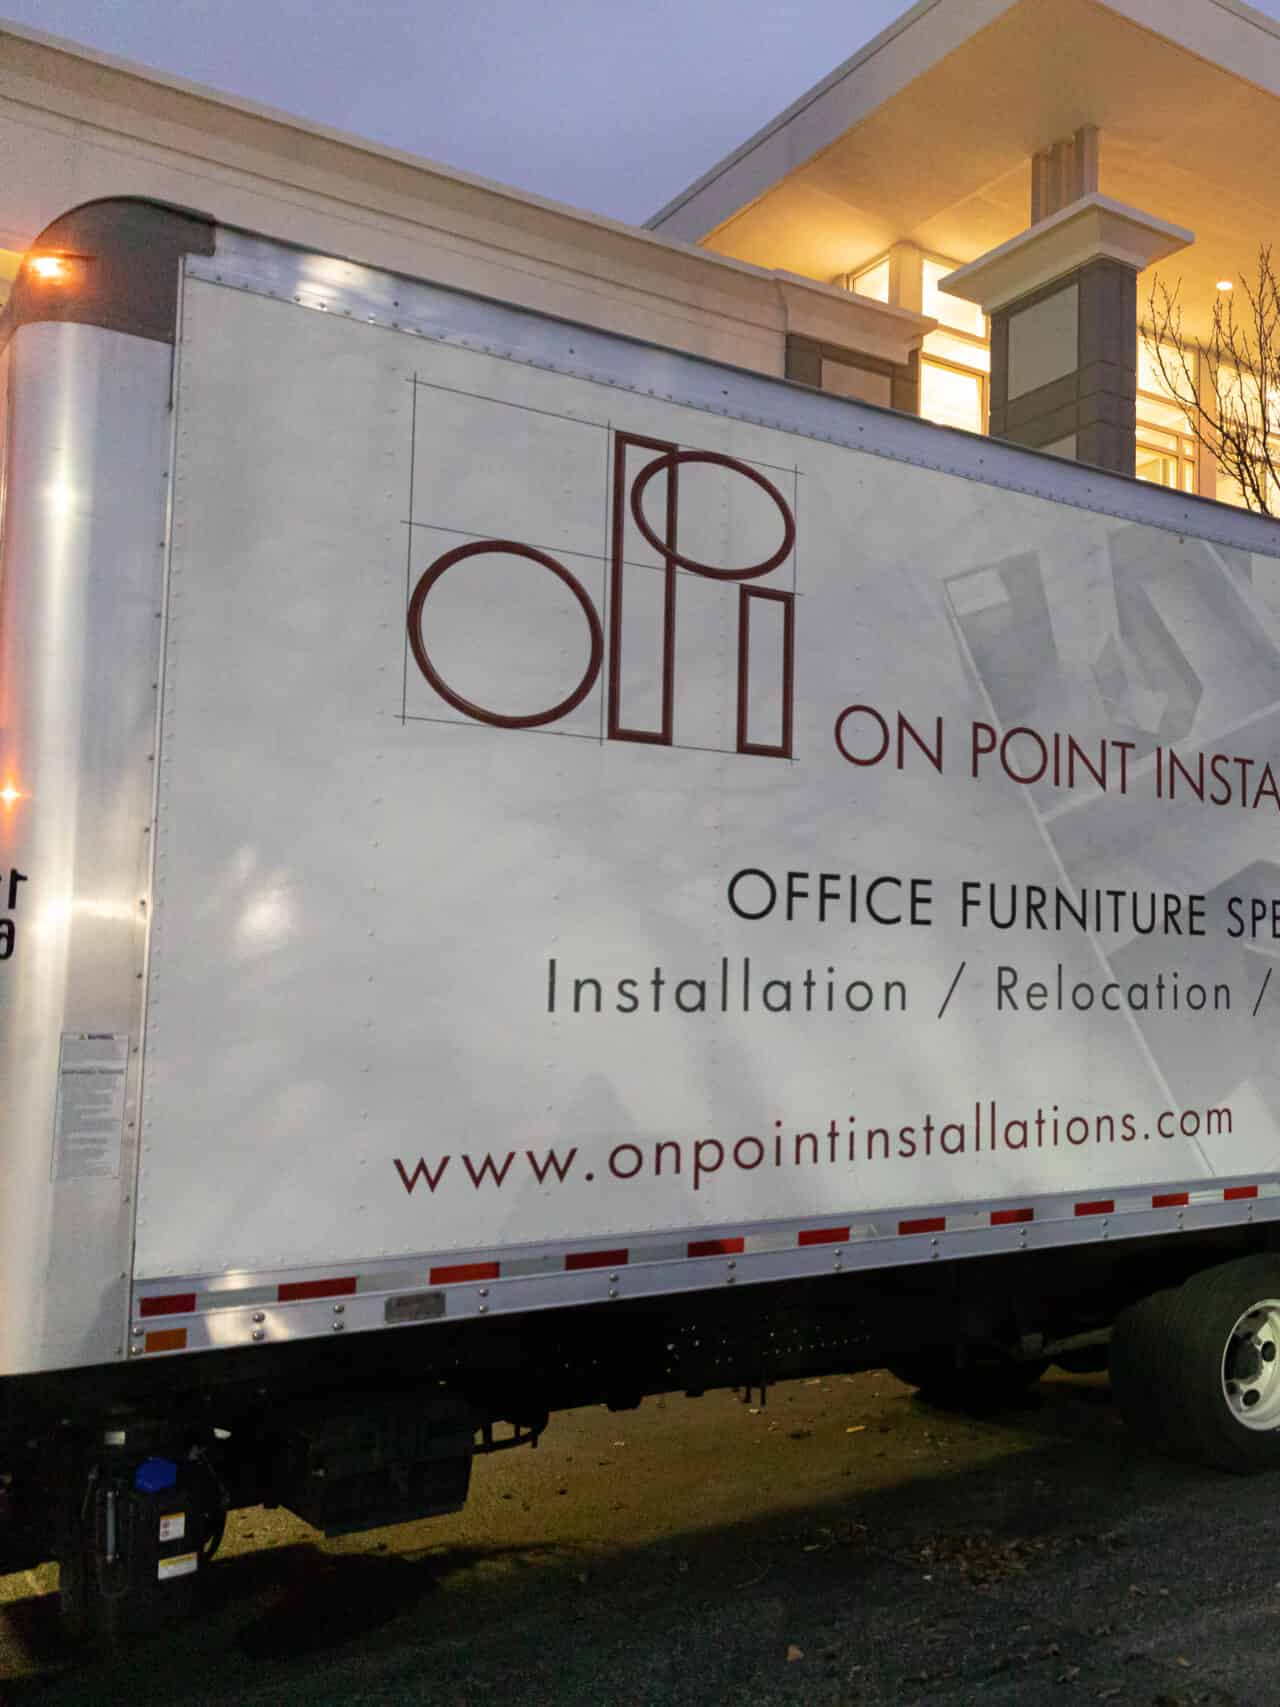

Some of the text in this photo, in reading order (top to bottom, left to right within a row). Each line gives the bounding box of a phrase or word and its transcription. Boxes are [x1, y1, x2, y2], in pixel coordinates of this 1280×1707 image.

[833, 704, 944, 775] ON
[971, 721, 1136, 795] POINT
[727, 867, 933, 926] OFFICE
[961, 881, 1207, 937] FURNITURE
[547, 957, 908, 1014] Installation
[997, 963, 1232, 1012] Relocation
[393, 1100, 1233, 1196] www.onpointinstallations.com
